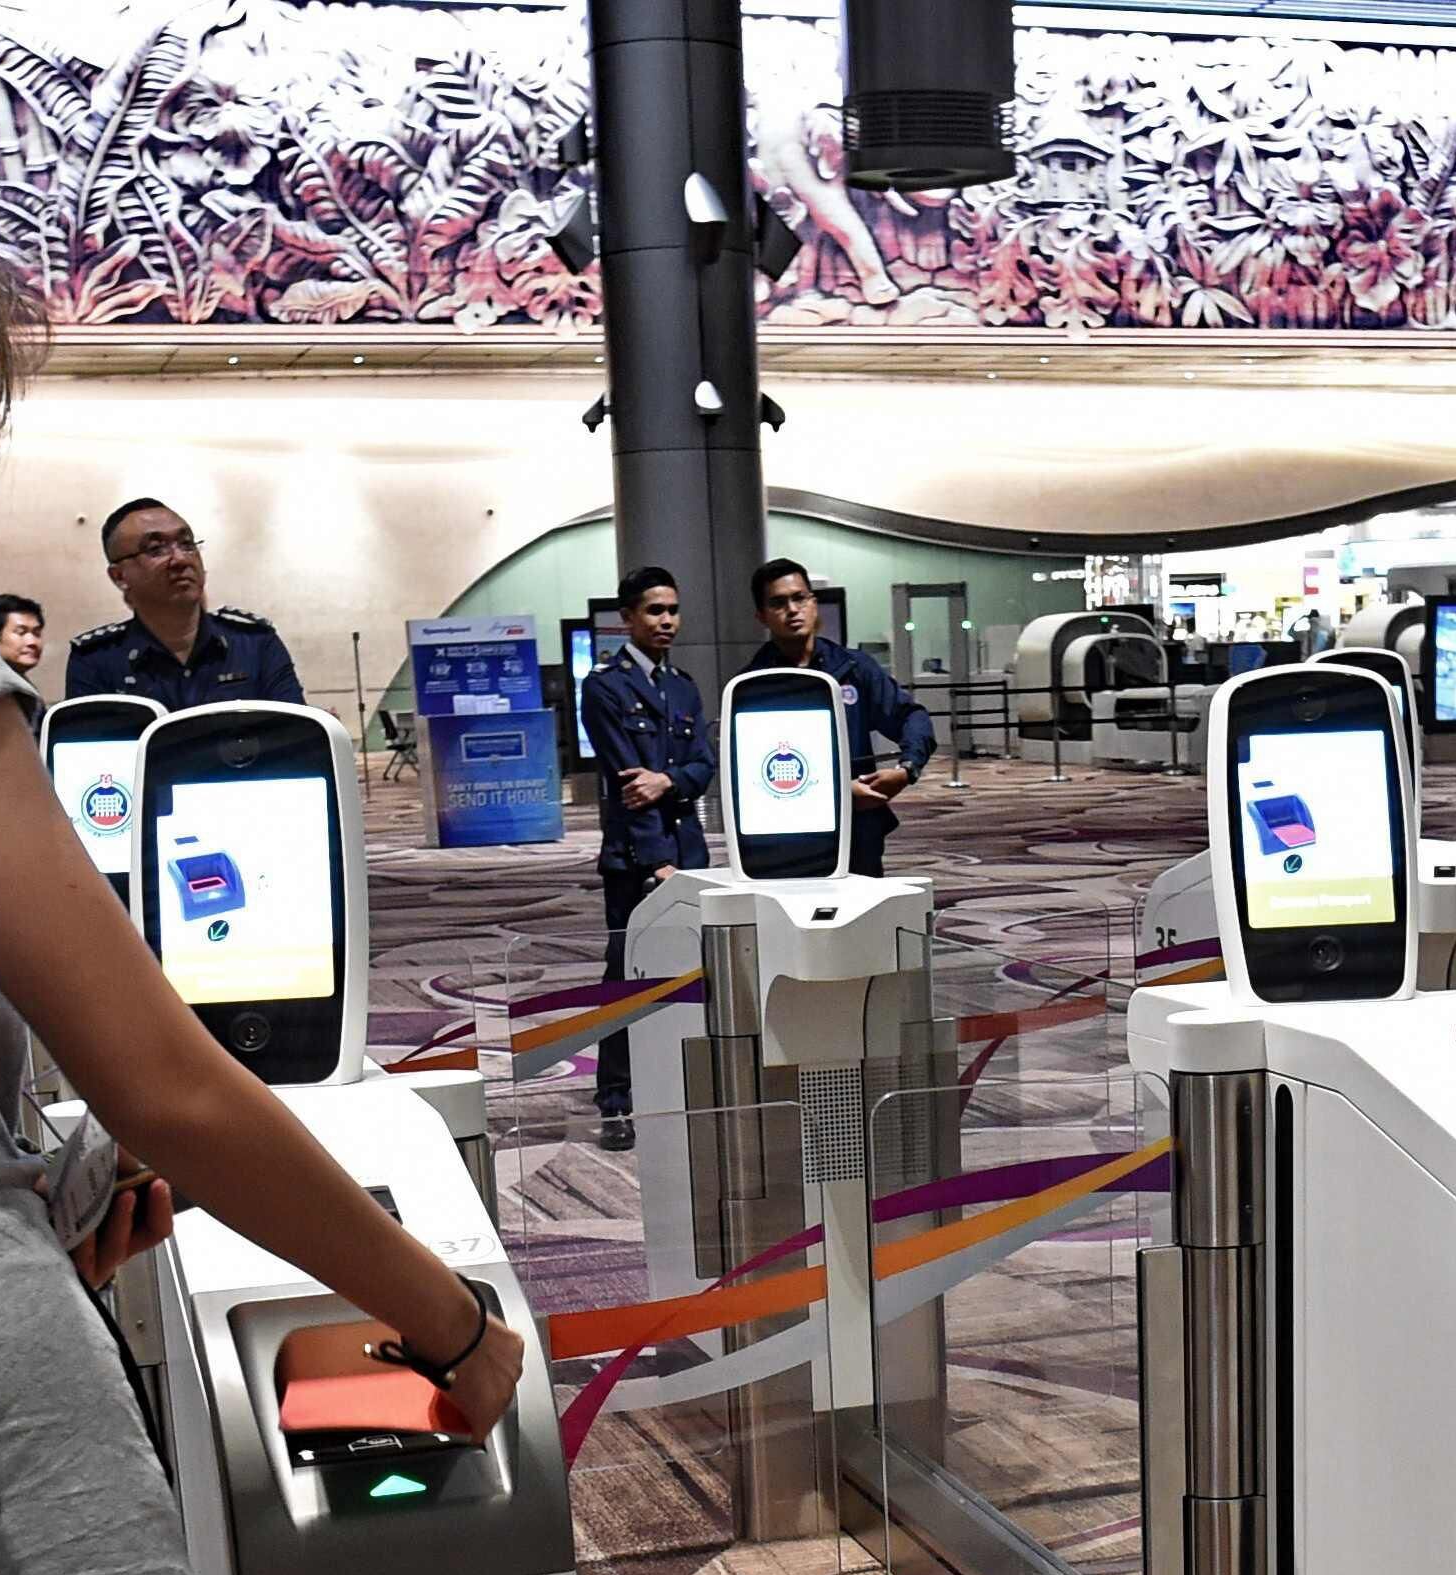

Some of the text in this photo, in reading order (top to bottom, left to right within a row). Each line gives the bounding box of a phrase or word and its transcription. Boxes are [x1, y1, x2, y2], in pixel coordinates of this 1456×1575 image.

[448, 788, 548, 808] SEND IT HOME
[438, 1237, 481, 1255] 37
